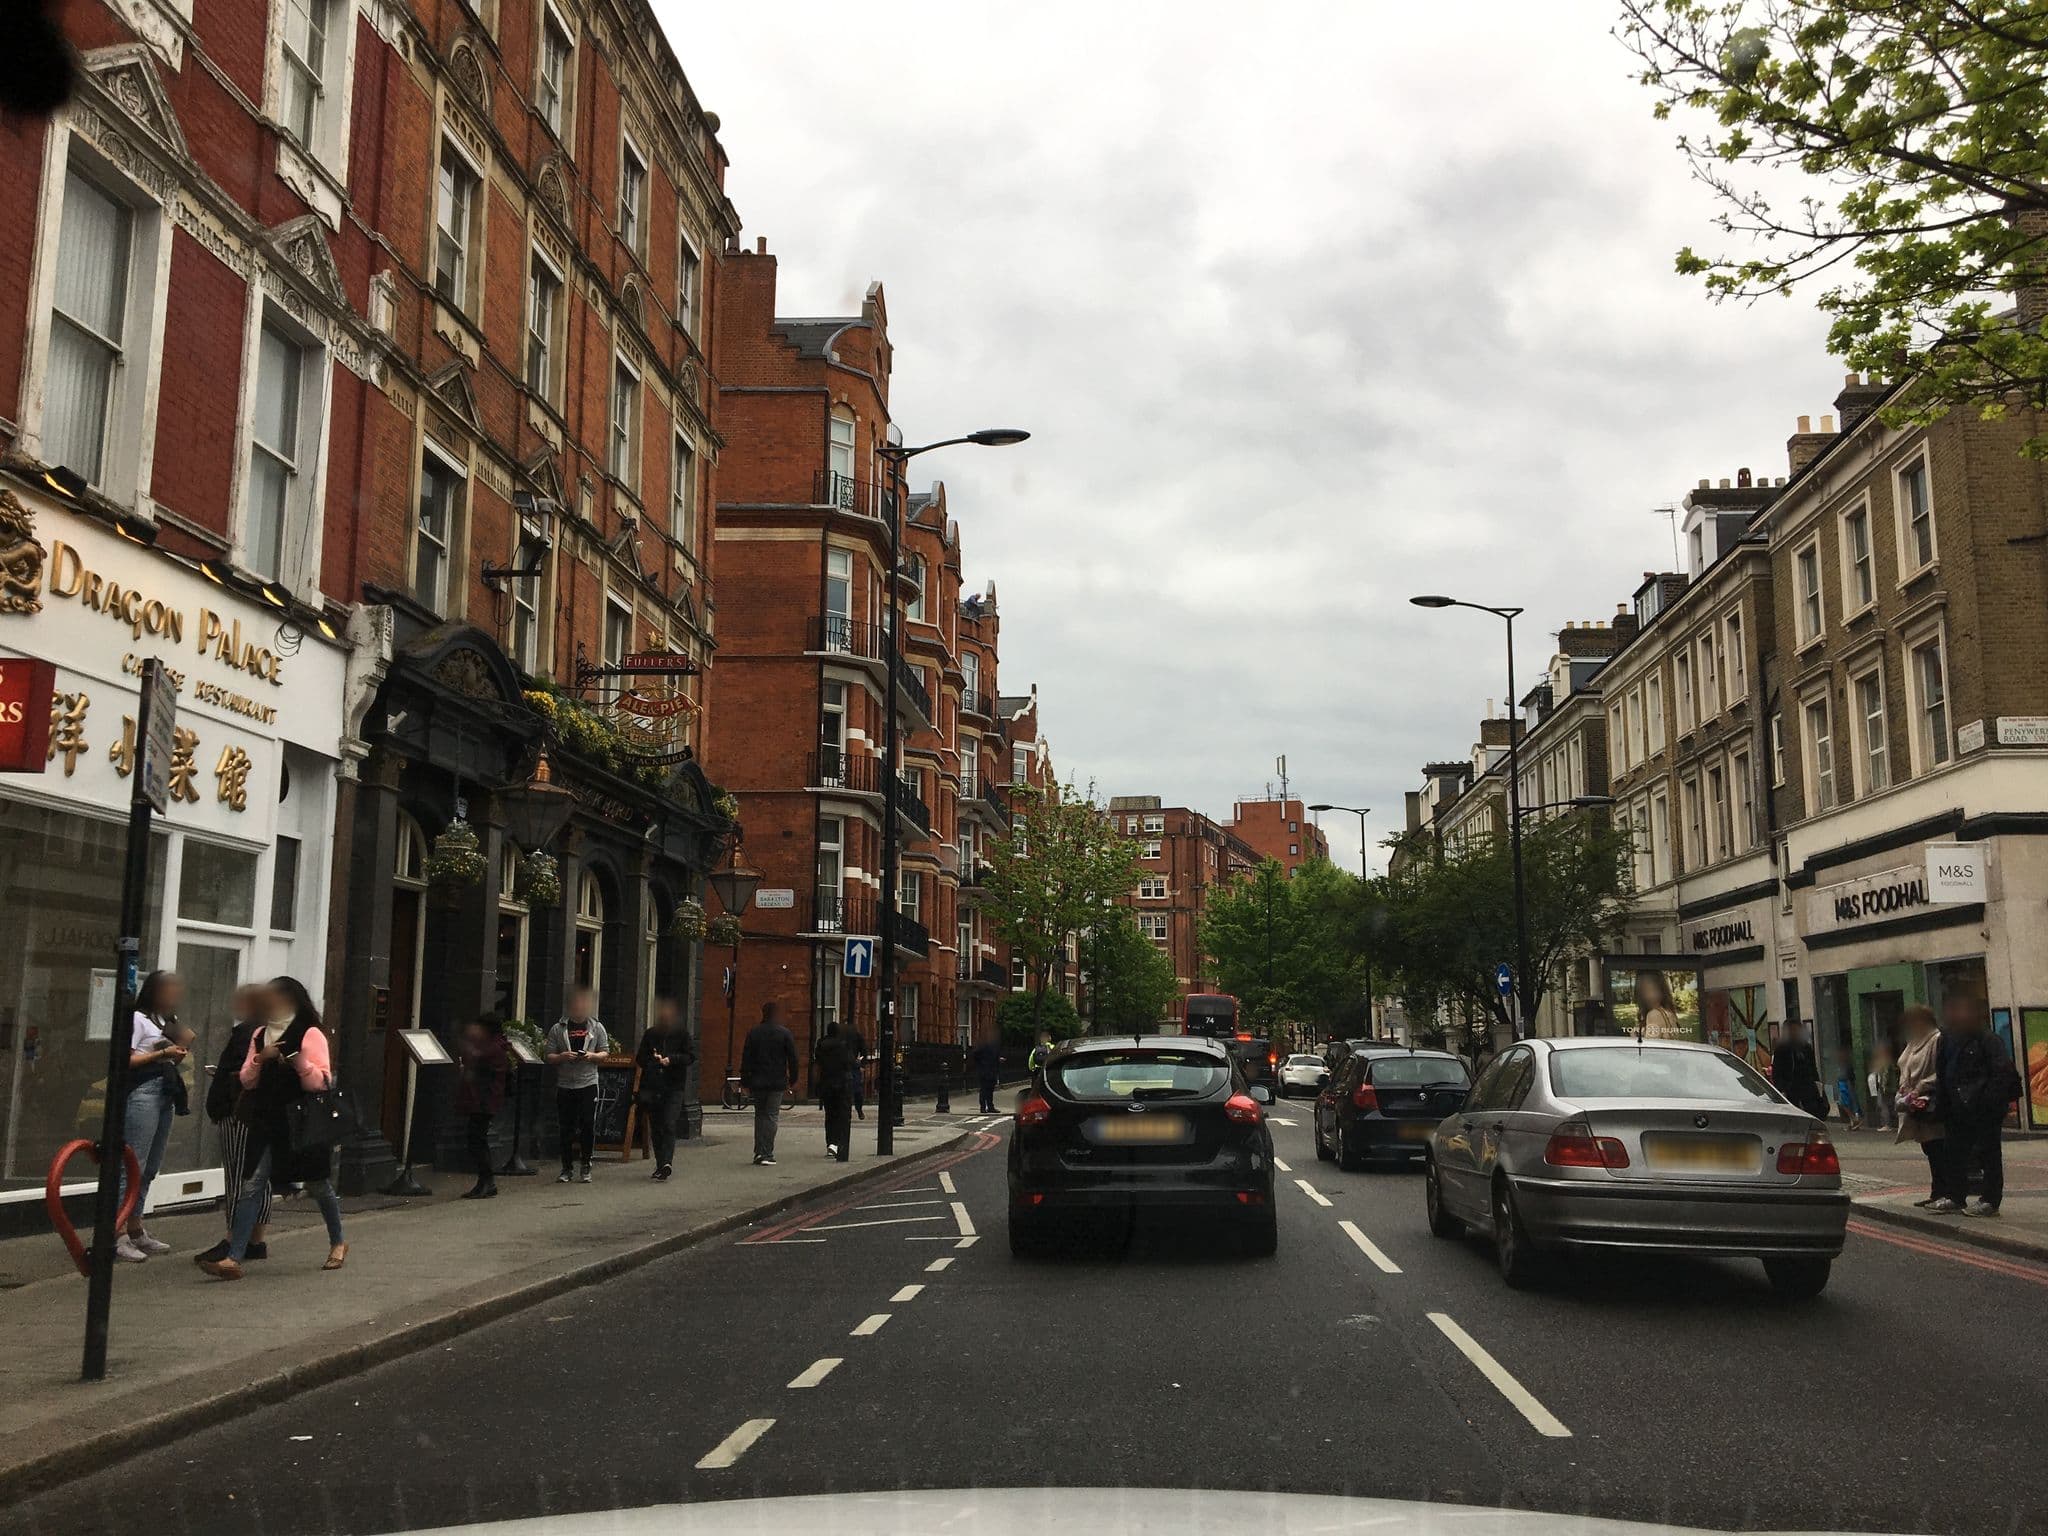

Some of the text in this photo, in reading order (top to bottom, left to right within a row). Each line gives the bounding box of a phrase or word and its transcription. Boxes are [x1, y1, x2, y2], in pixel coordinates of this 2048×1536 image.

[2004, 728, 2048, 736] PENYWER
[1939, 865, 1973, 878] M&S
[1862, 879, 1929, 915] FOODHAL
[1205, 1016, 1215, 1025] 74
